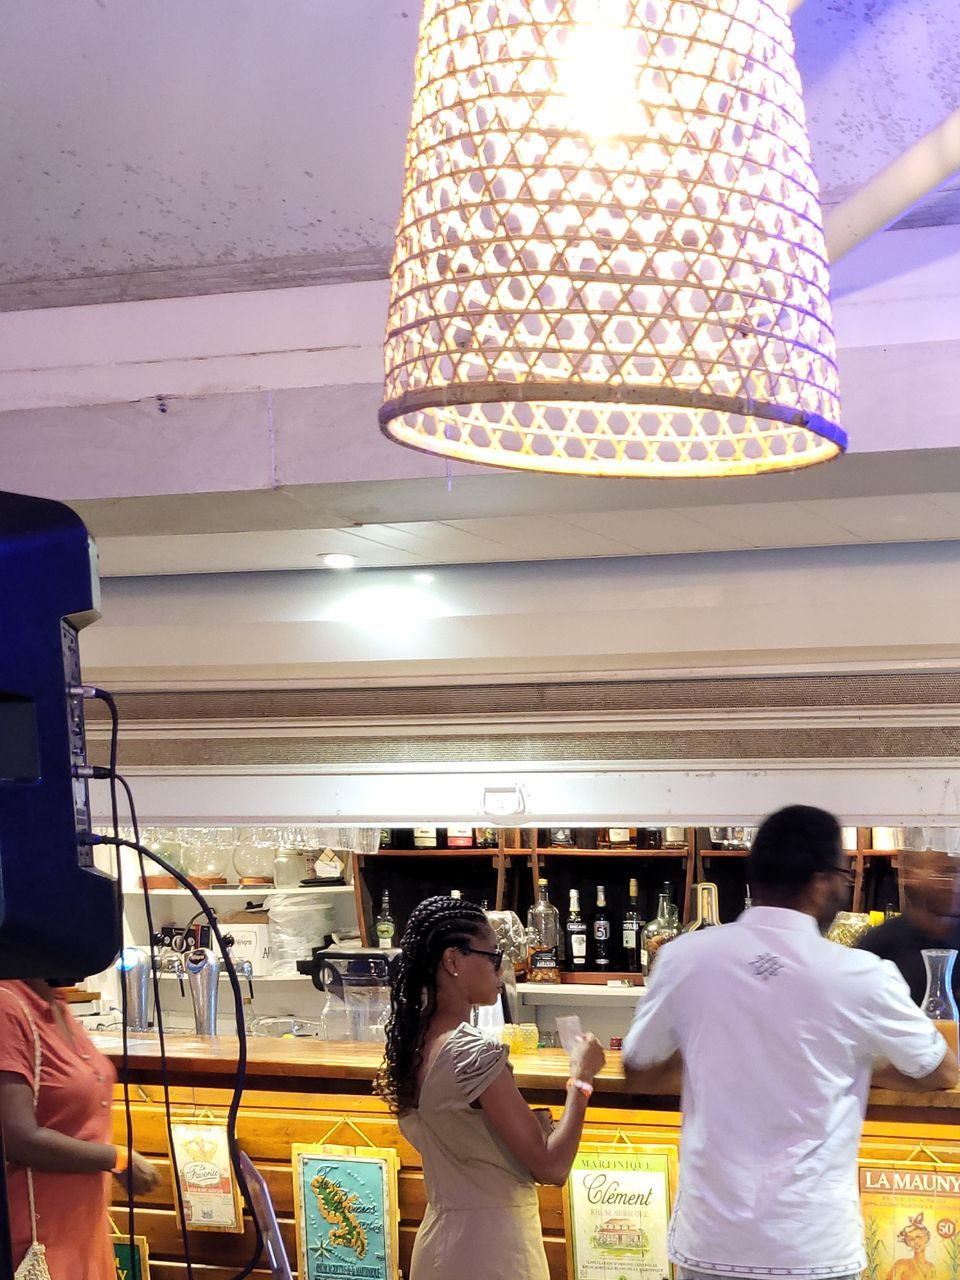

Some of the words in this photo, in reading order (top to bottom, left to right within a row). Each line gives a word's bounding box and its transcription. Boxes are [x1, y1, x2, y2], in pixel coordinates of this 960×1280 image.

[581, 1159, 652, 1171] MARTINIQUE
[865, 1171, 891, 1189] LA
[583, 1173, 653, 1206] Clément
[938, 1222, 954, 1234] 50
